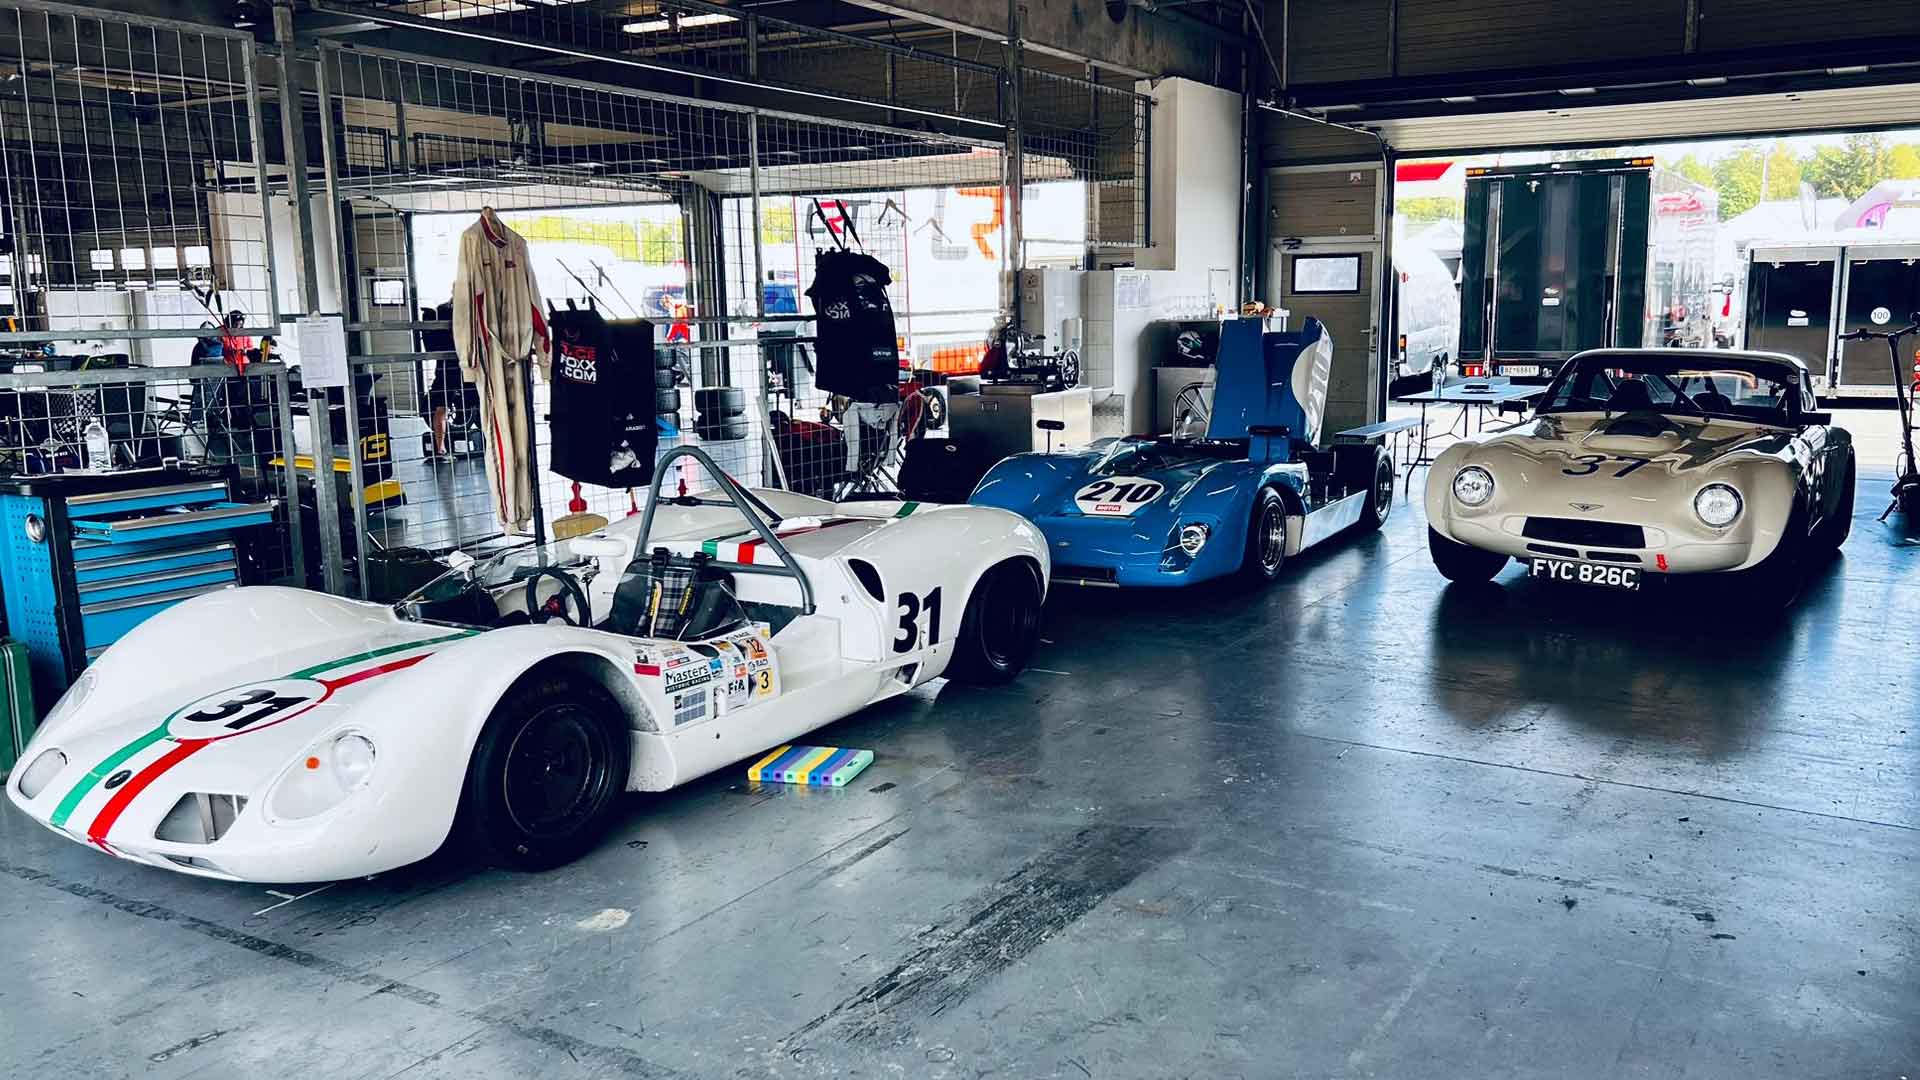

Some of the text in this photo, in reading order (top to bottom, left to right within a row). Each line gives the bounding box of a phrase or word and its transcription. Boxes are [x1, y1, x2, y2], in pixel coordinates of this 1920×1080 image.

[1873, 311, 1888, 319] 100
[559, 352, 597, 371] FOXX
[559, 366, 597, 382] .COM
[359, 433, 388, 461] 13
[1562, 454, 1652, 478] 37
[1077, 481, 1162, 503] 210
[1532, 558, 1637, 588] FYC 826C
[892, 586, 942, 654] 31
[746, 638, 764, 653] 12
[665, 664, 709, 685] Masters
[761, 671, 769, 689] 3
[183, 688, 311, 730] 31
